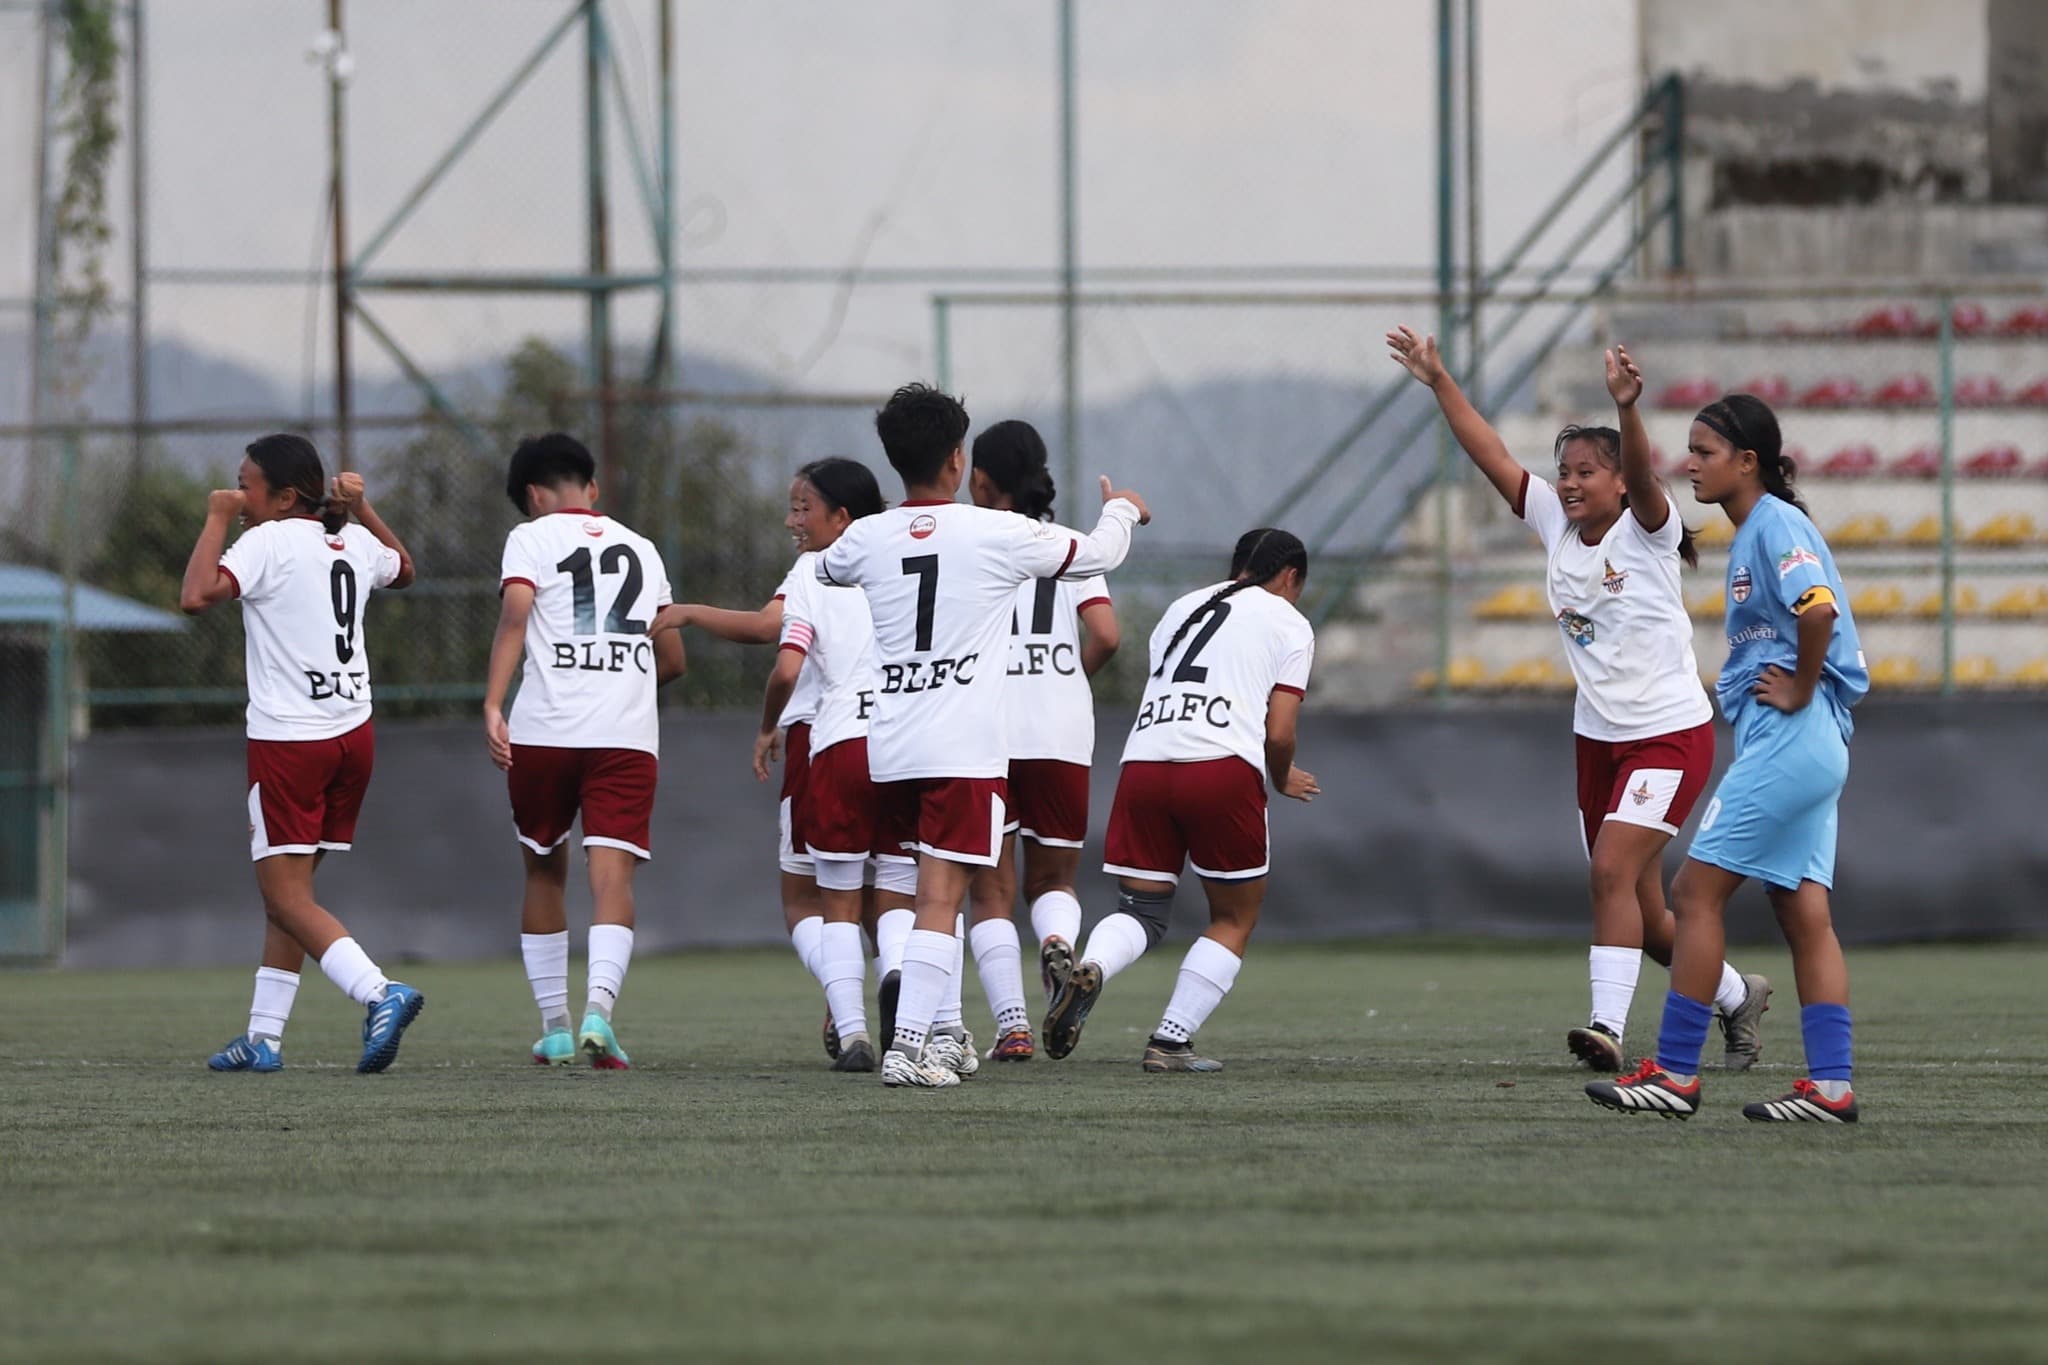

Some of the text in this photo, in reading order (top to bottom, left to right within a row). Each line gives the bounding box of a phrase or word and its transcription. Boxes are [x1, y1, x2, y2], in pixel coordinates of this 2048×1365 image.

[330, 558, 357, 665] 9
[556, 543, 647, 635] 12
[901, 553, 939, 652] 7
[551, 640, 651, 674] BLFC
[881, 653, 979, 694] BLFC
[1135, 692, 1232, 732] BLFC
